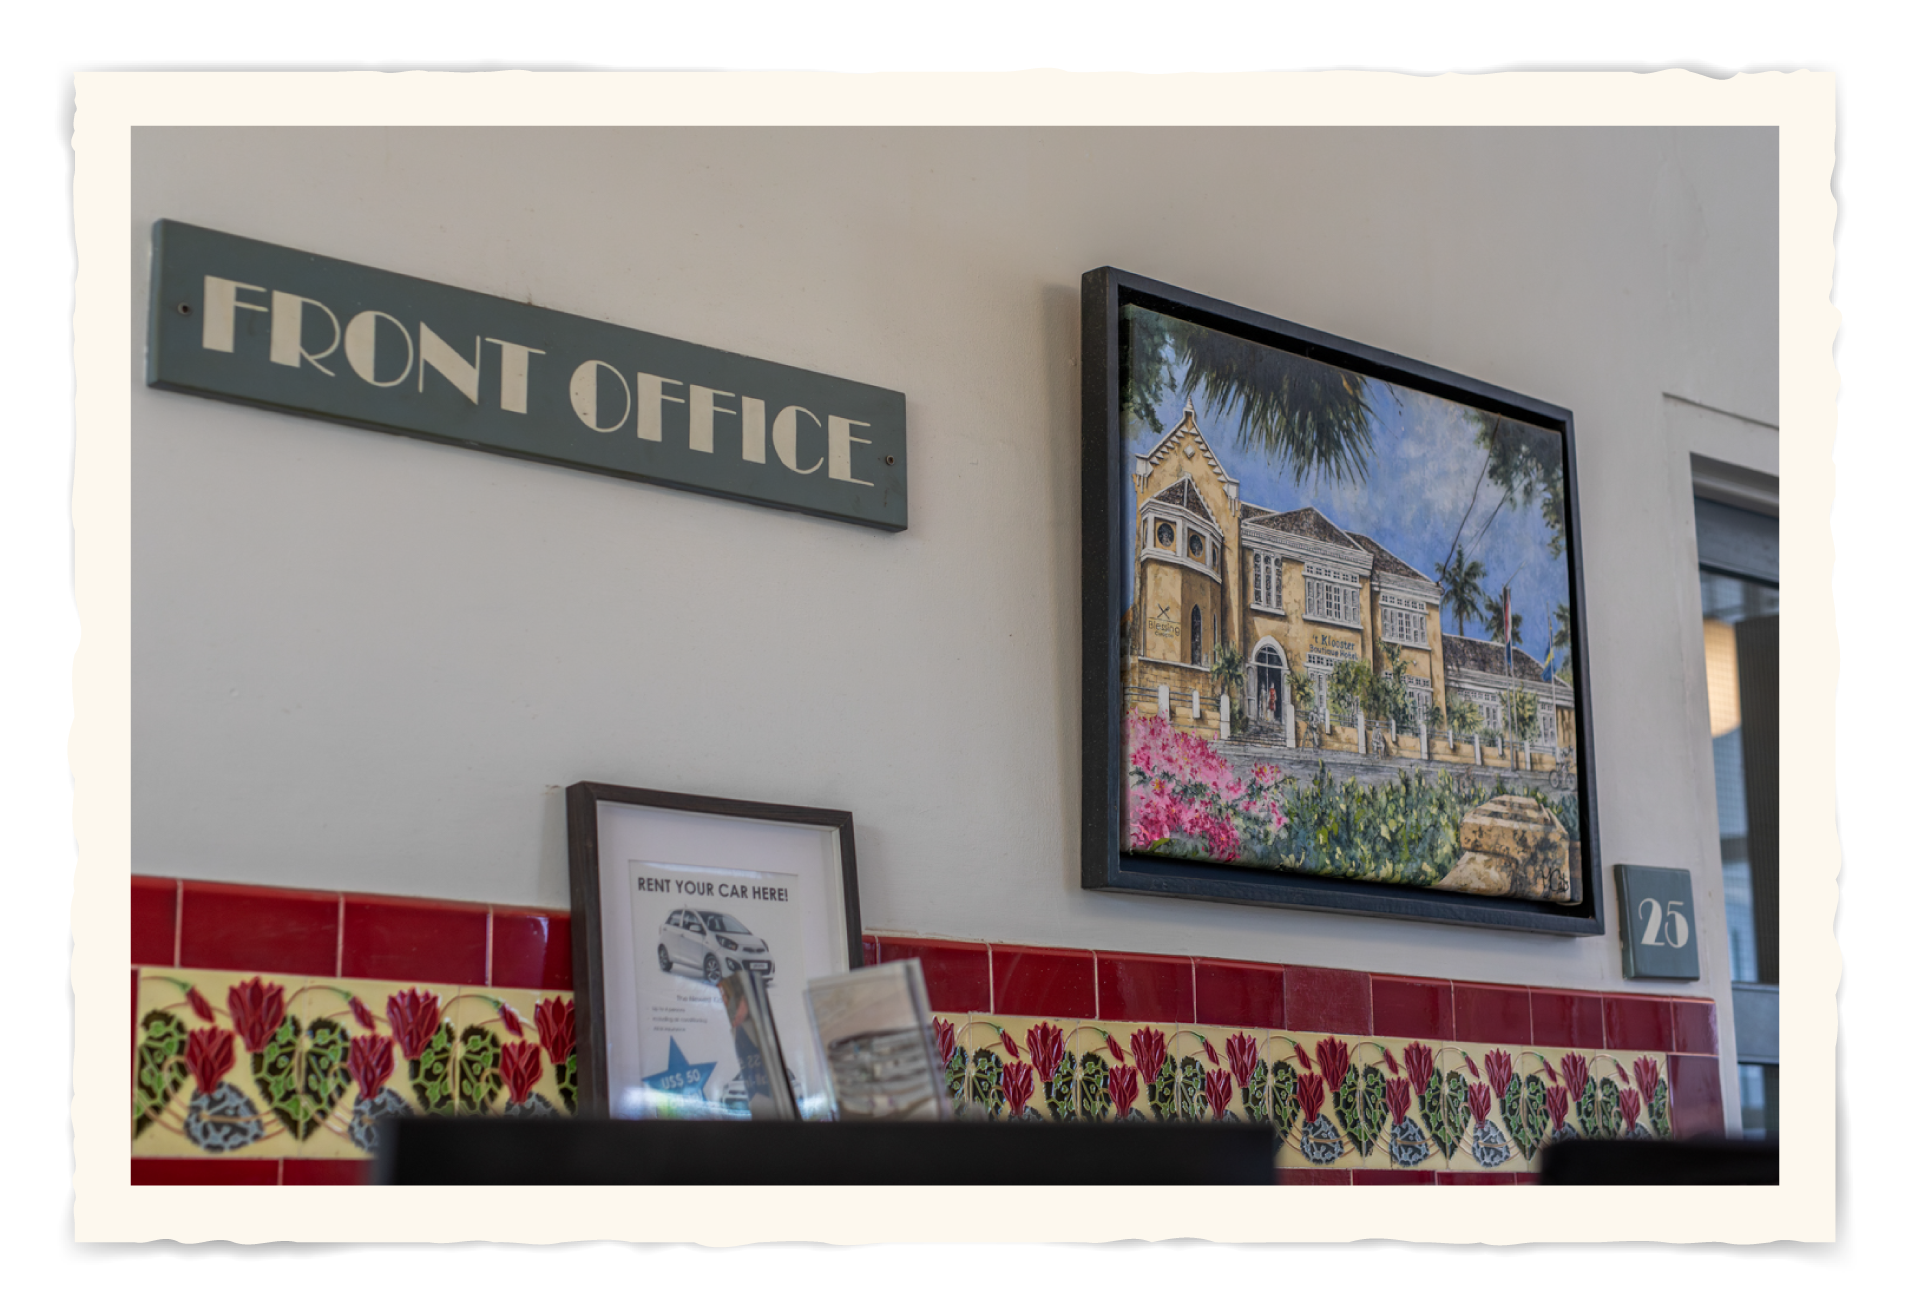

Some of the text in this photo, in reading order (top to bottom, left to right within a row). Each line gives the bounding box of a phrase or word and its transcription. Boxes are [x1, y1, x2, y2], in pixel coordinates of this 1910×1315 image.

[202, 275, 875, 487] FRONT OFFICE
[1321, 634, 1355, 650] Klooster
[638, 877, 788, 902] RENT YOUR CAR HERE!
[1638, 898, 1689, 949] 25
[686, 1068, 701, 1084] 50
